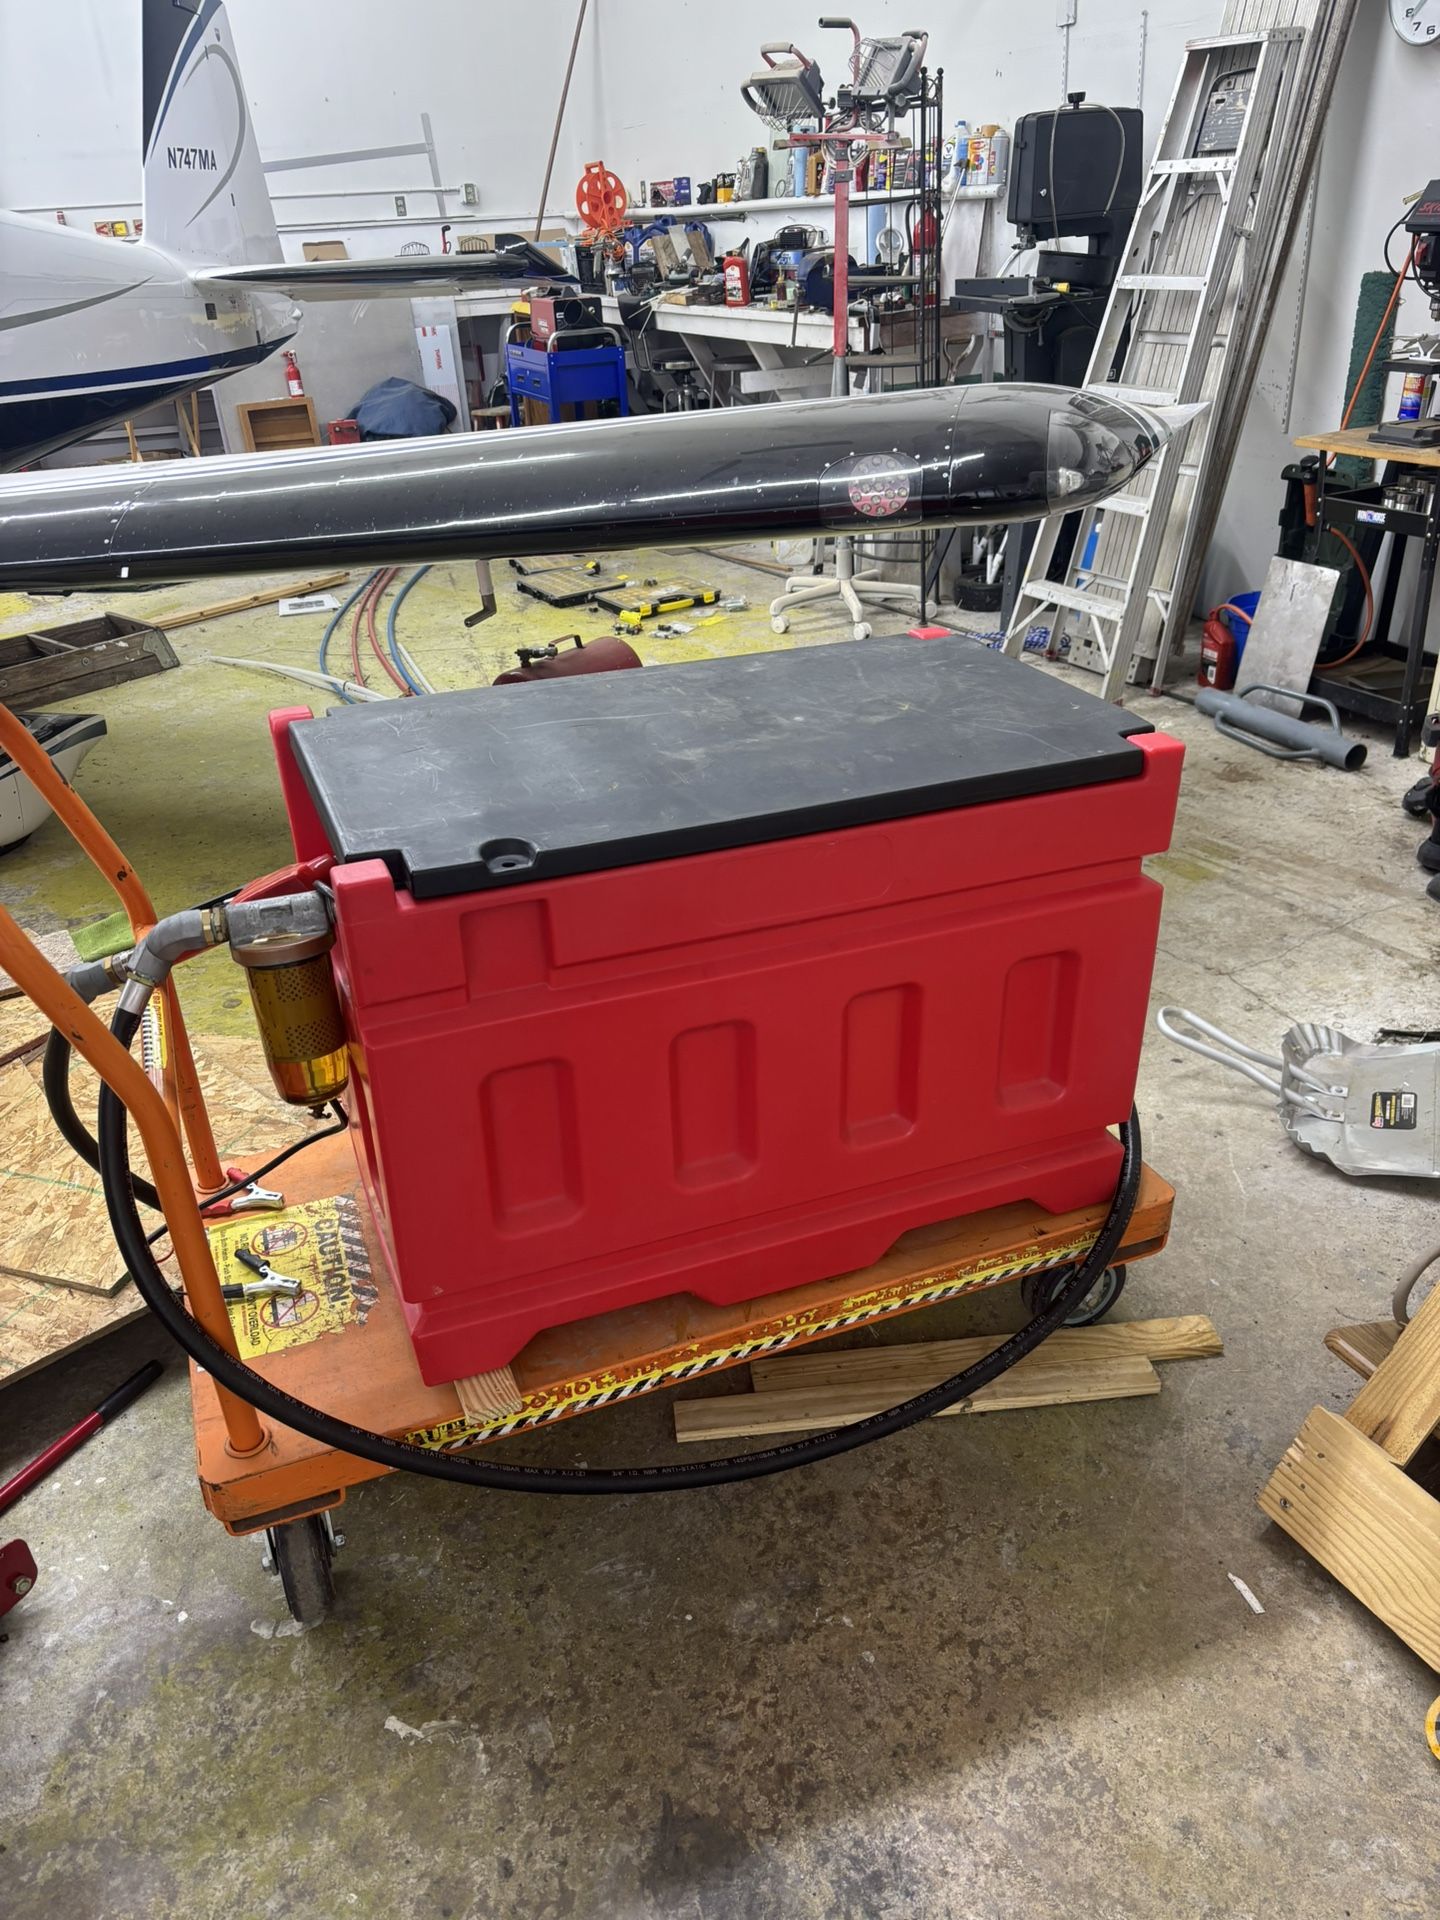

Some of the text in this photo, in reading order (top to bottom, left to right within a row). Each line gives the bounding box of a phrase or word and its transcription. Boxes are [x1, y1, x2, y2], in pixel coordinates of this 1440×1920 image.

[1412, 21, 1422, 32] 7
[1426, 25, 1436, 35] 6
[167, 146, 218, 171] N747MA
[246, 1291, 261, 1347] ON'T OVERLOAD
[400, 1444, 447, 1460] ANTI-STATIC
[450, 1456, 470, 1465] HOSE
[662, 1463, 706, 1474] ANTI-STATIC
